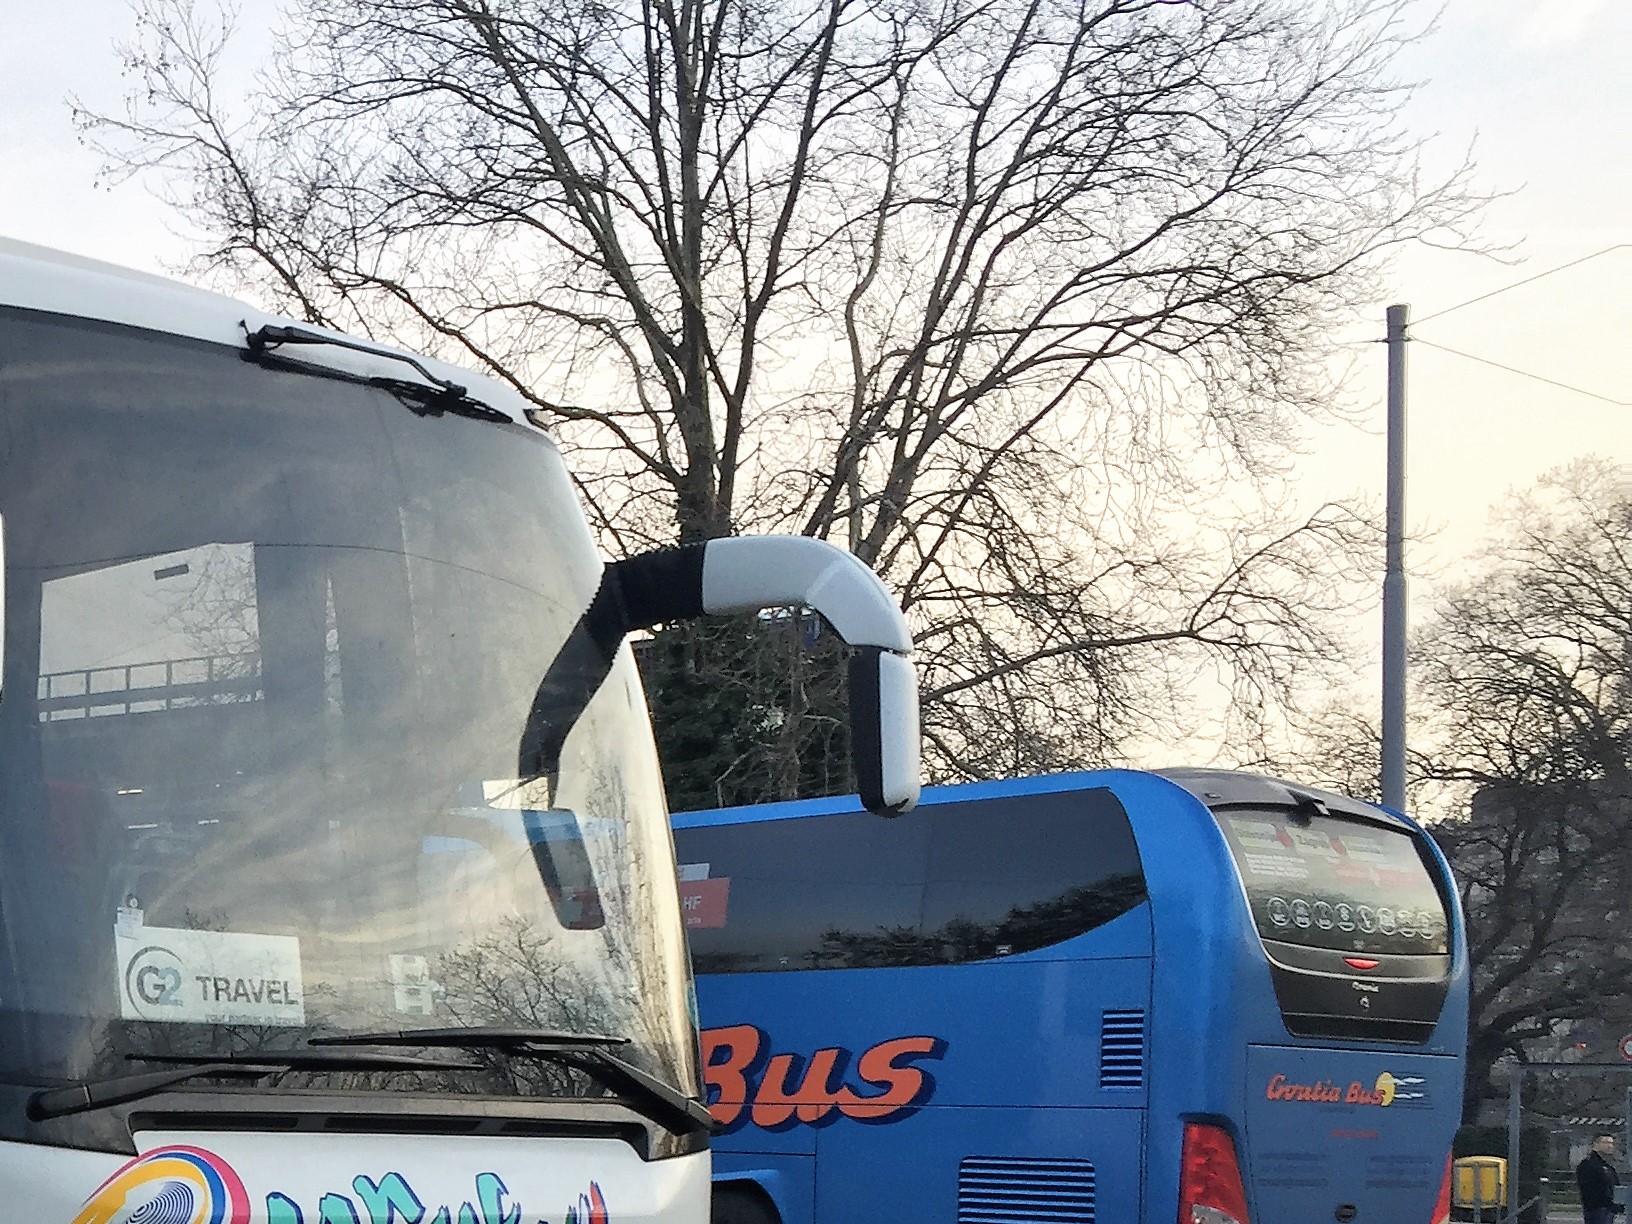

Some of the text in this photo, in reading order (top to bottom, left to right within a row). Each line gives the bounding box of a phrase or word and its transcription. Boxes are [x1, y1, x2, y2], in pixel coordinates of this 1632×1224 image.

[136, 965, 299, 1007] G2 TRAVEL
[701, 1022, 942, 1127] Bus
[1344, 1080, 1386, 1105] Bus
